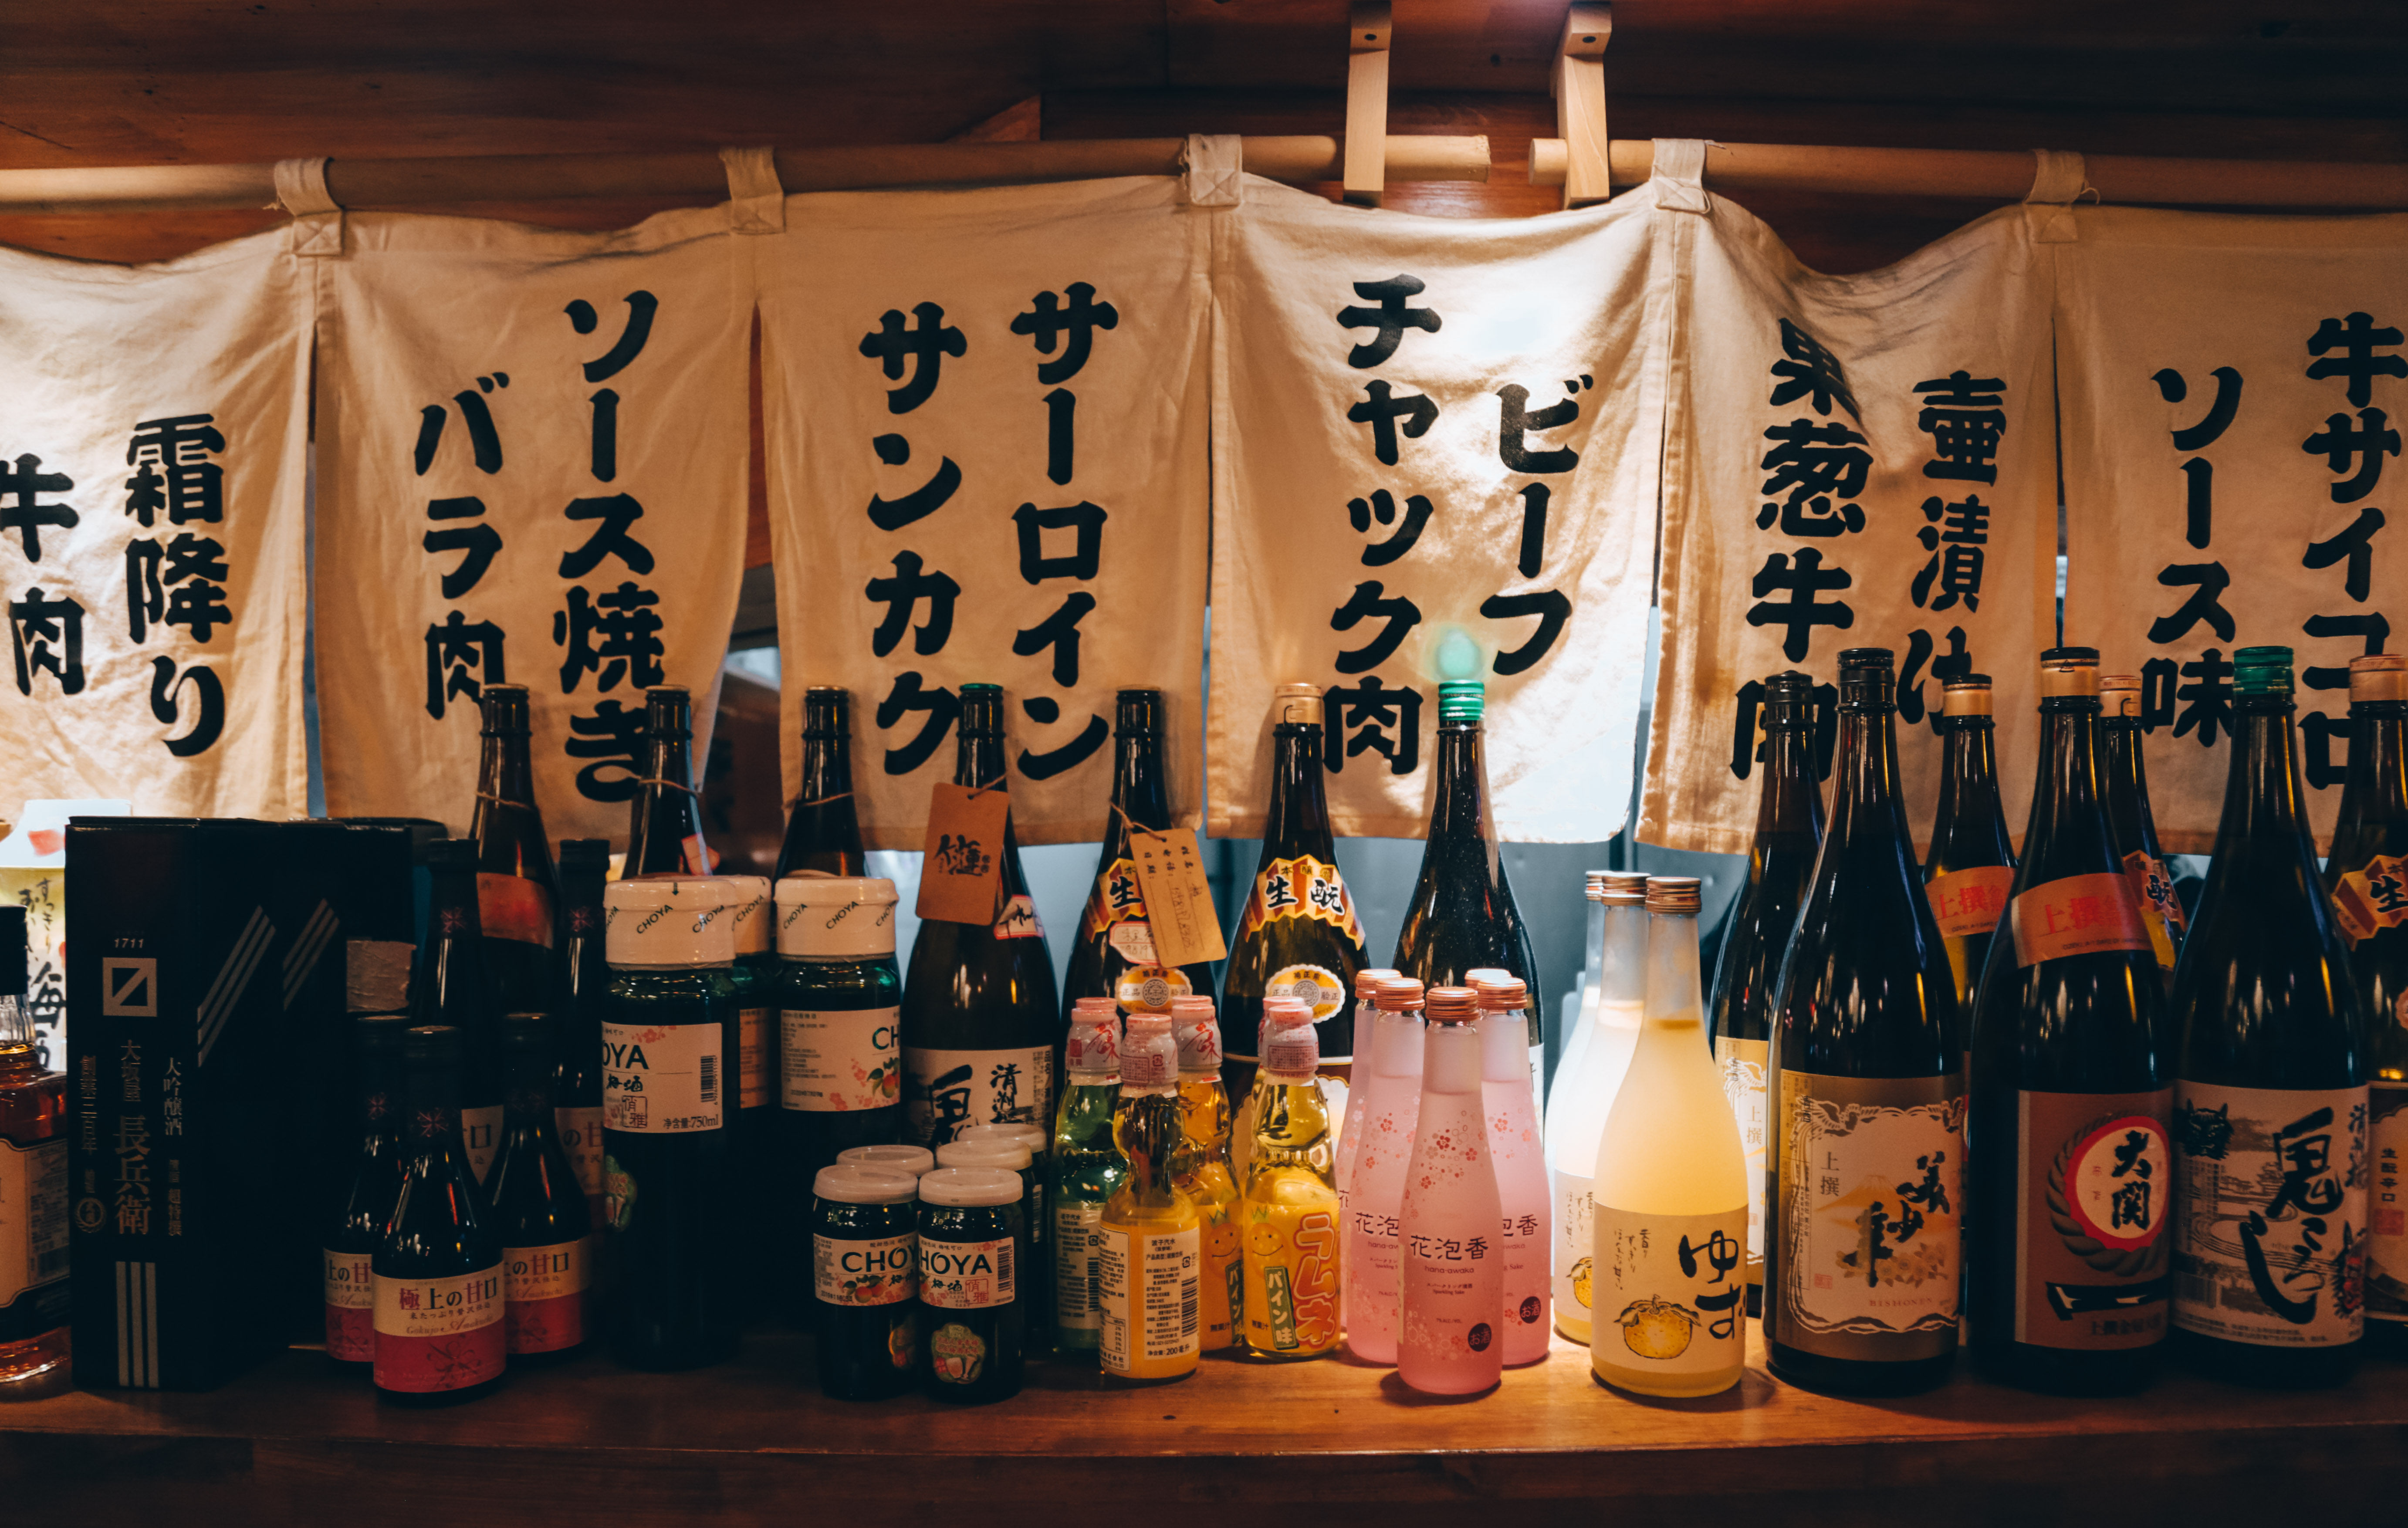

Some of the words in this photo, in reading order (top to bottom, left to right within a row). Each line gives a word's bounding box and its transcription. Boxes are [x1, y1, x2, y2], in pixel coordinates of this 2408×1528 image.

[414, 372, 510, 720] バラ肉
[552, 290, 665, 801] ソース焼き
[859, 301, 967, 775] サンカク
[1010, 282, 1119, 780] サーロイン
[1322, 274, 1443, 774] チャック肉
[1480, 375, 1594, 675] ビーフ
[0, 453, 85, 696] 牛肉
[125, 413, 233, 757] 霜降り
[2141, 366, 2244, 747] ソース味
[636, 905, 673, 934] CHOYA
[692, 905, 725, 933] CHOYA
[736, 894, 764, 922] CHOYA
[783, 904, 808, 930] CHOYA
[826, 901, 859, 930] CHOYA
[1109, 876, 1143, 909] 生
[114, 937, 145, 948] 1711
[1746, 1105, 1762, 1145] 上撰
[112, 1115, 152, 1235] 長兵衛
[1820, 1151, 1840, 1197] 上撰
[2112, 1130, 2153, 1231] 大関
[1356, 1212, 1399, 1237] 花泡
[1410, 1235, 1488, 1260] 花泡香
[399, 1277, 497, 1310] 極上の甘口
[1293, 1212, 1337, 1348] ラムネ
[1425, 1265, 1474, 1274] hana-awaka
[1678, 1230, 1746, 1340] ゆず
[1268, 1271, 1293, 1344] パイン味
[1869, 1297, 1933, 1307] BISHONEN
